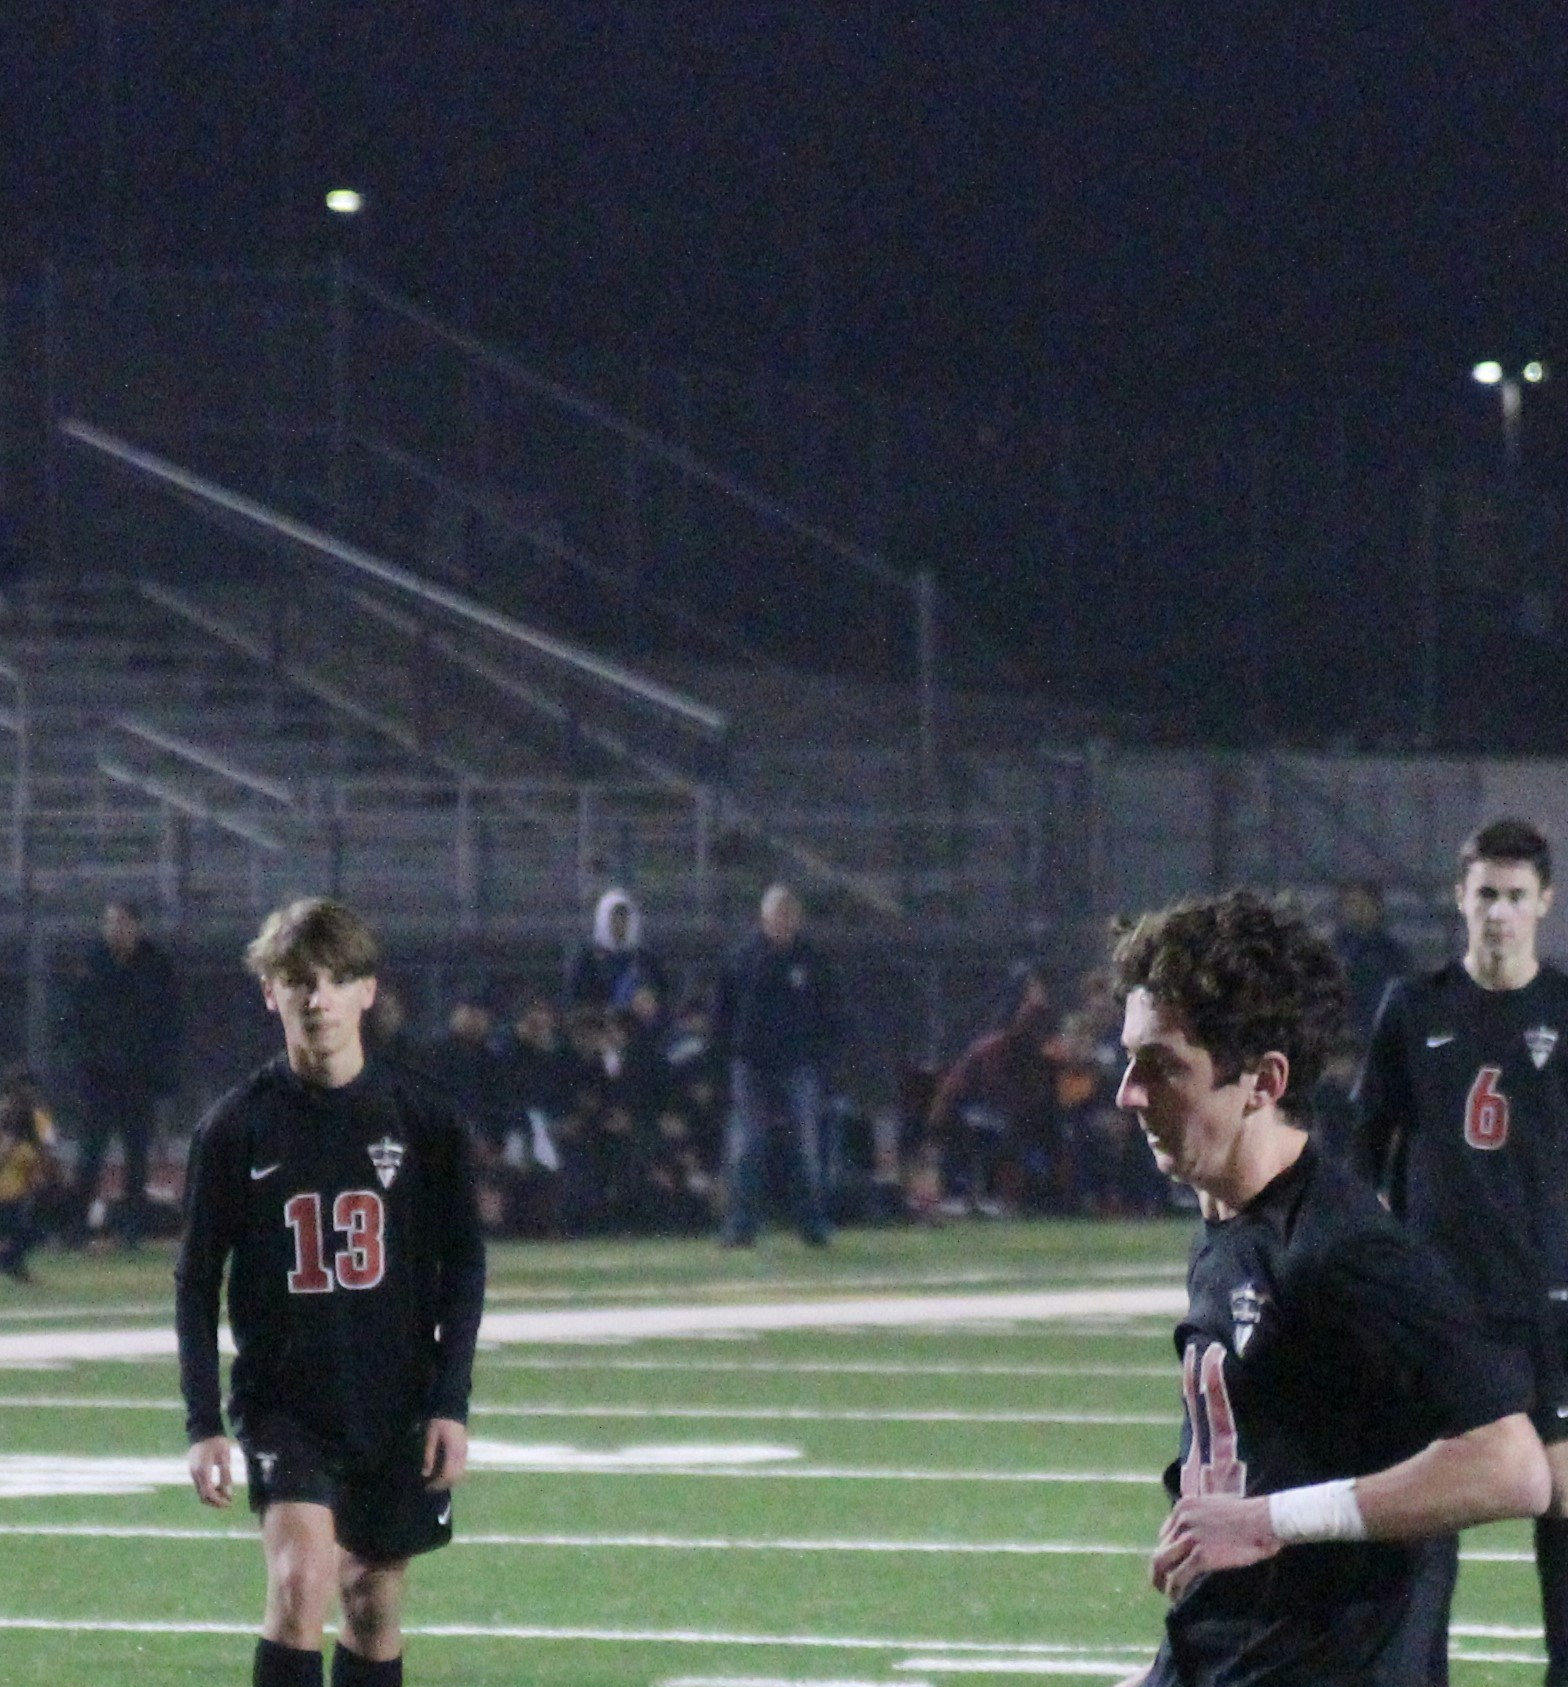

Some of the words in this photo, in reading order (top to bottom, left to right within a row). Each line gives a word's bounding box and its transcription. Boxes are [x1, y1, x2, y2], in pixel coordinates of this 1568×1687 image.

[1463, 1065, 1510, 1150] 6
[284, 1190, 385, 1293] 13
[1180, 1341, 1248, 1498] 11
